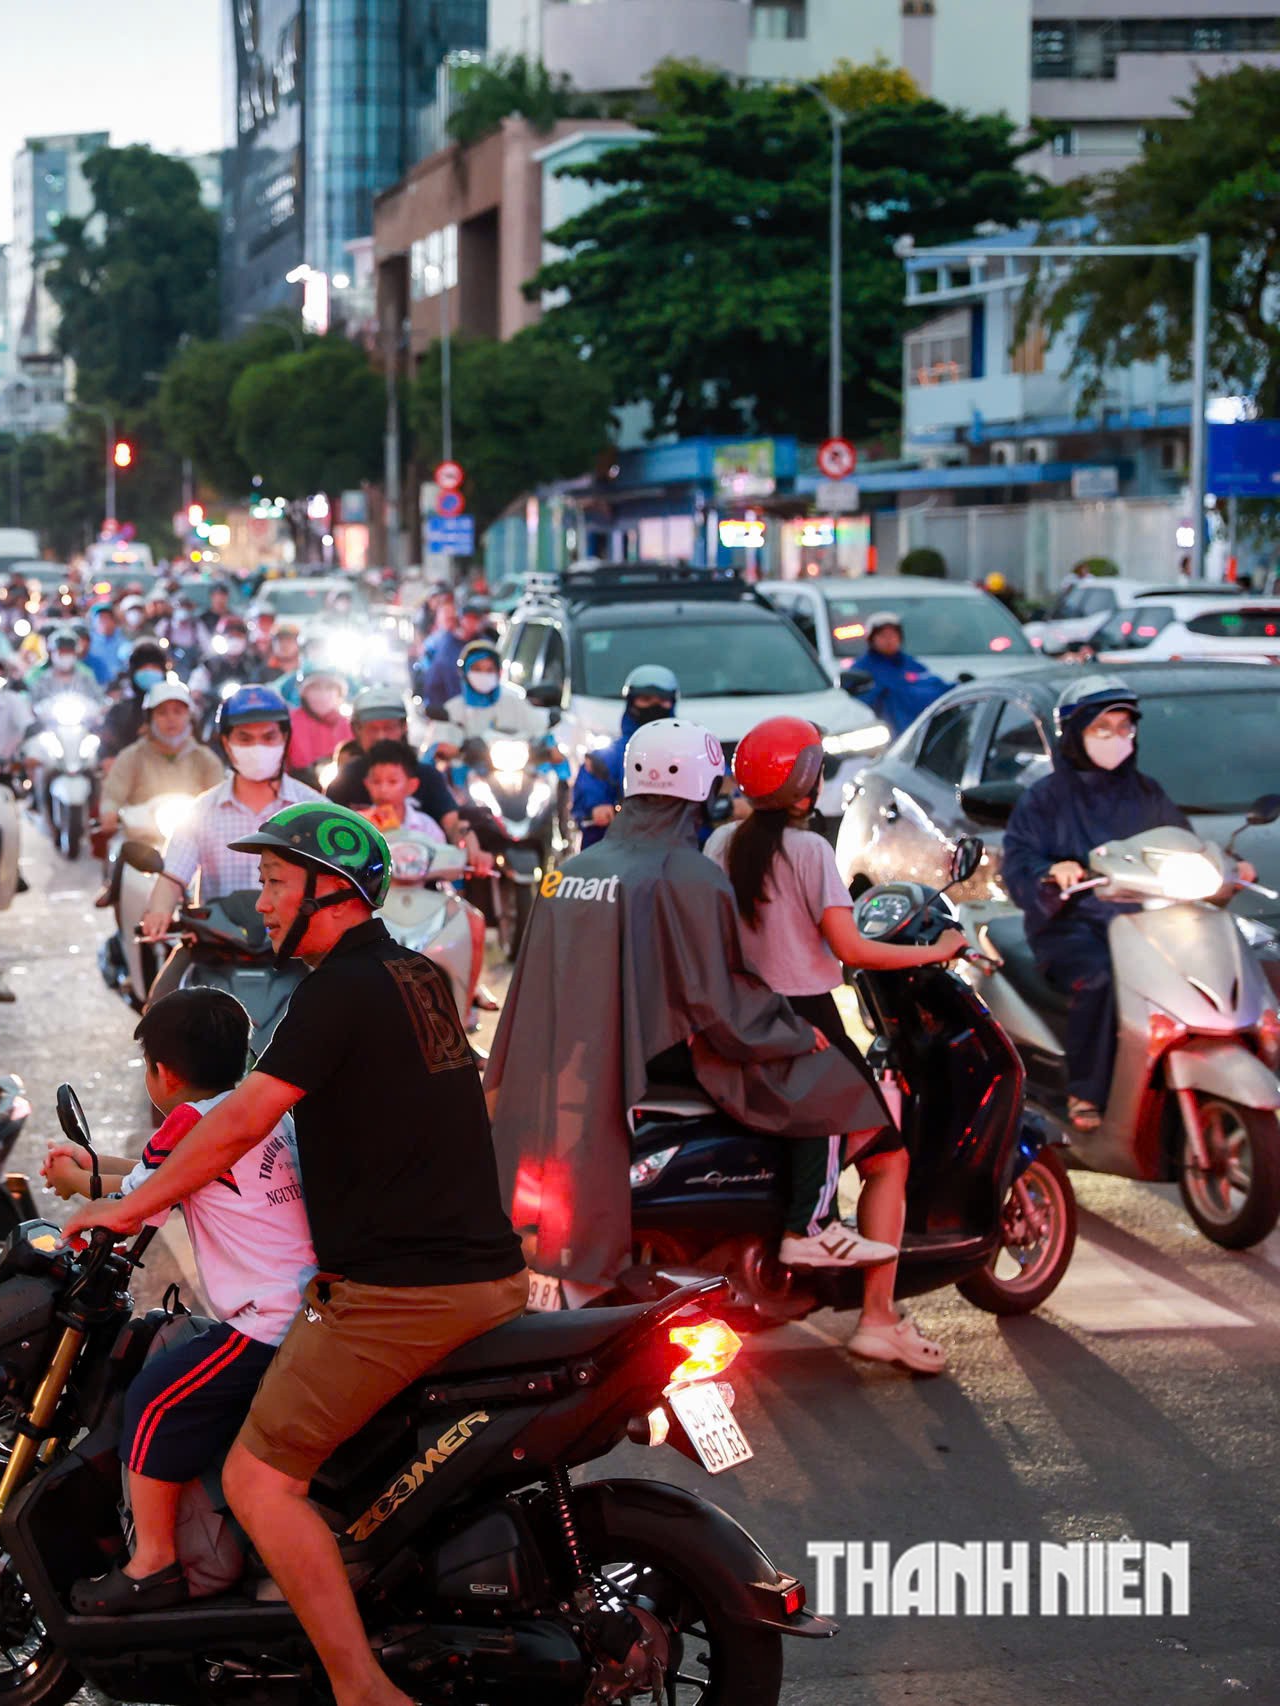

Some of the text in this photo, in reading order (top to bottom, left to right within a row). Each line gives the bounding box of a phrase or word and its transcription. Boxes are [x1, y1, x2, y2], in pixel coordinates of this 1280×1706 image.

[540, 870, 620, 903] emart
[697, 1423, 748, 1467] 697.63
[345, 1410, 490, 1541] ZOOMER
